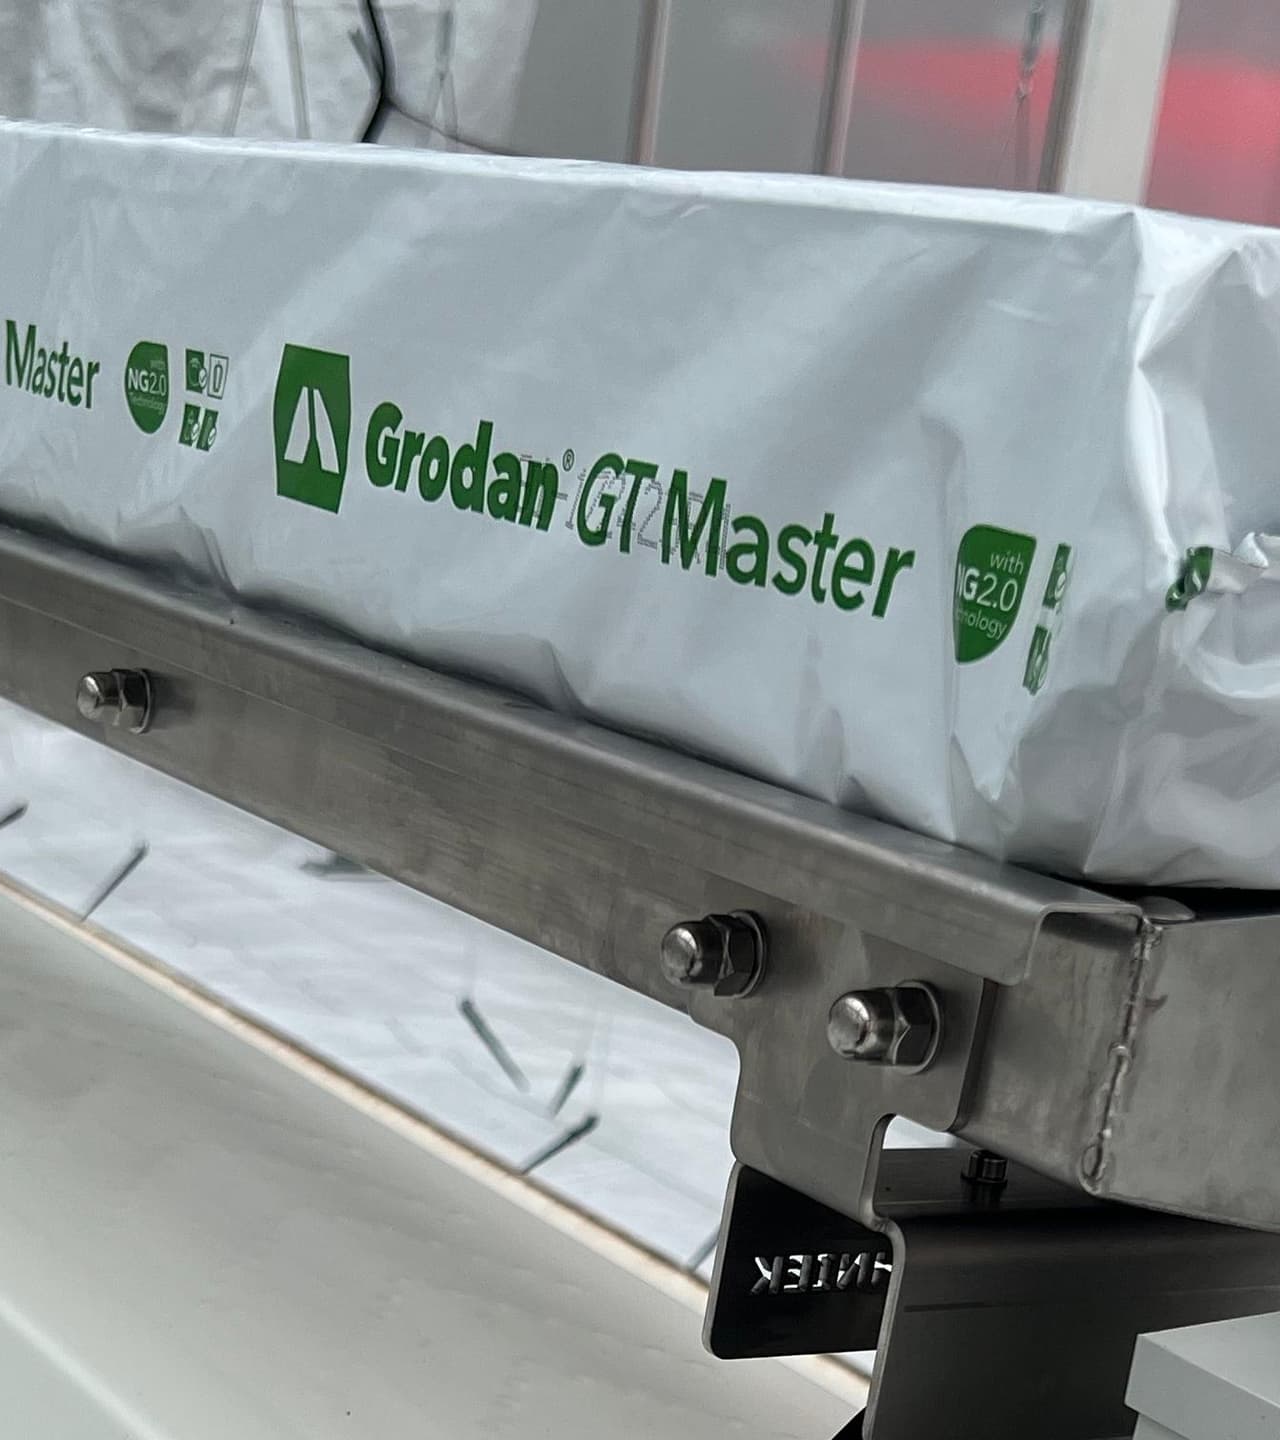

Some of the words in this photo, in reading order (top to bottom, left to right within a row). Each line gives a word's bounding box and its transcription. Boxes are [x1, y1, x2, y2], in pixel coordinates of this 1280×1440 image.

[5, 319, 101, 409] Master
[576, 452, 658, 554] GT
[660, 469, 915, 619] Master
[990, 551, 1024, 576] with
